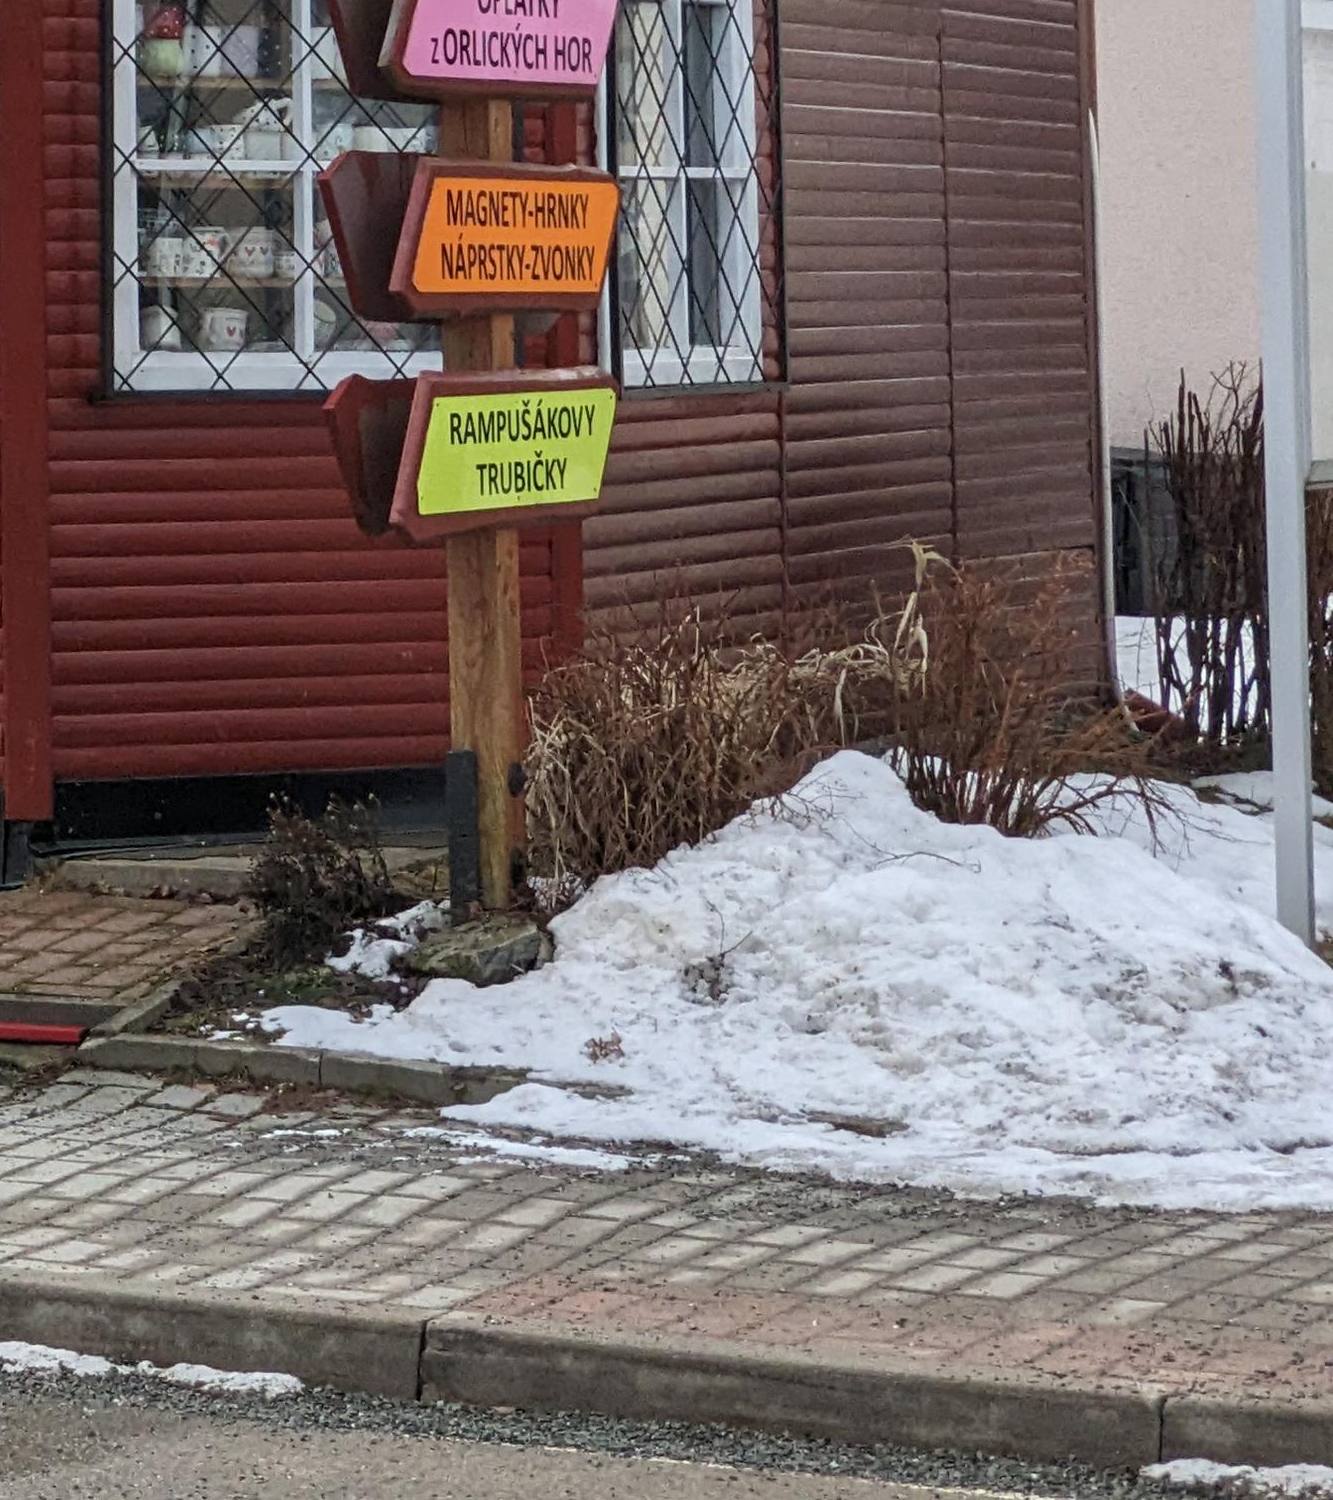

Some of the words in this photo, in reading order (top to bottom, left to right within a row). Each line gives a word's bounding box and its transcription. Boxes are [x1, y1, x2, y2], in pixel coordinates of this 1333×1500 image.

[443, 23, 548, 70] ORLICKÝCH
[554, 35, 593, 74] HOR
[446, 189, 589, 229] MAGNETY-HRNKY
[441, 232, 596, 281] NÁPRSTKY-ZVONKY
[449, 399, 596, 446] RAMPUŠÁKOVY
[476, 450, 568, 496] TRUBIČKY
